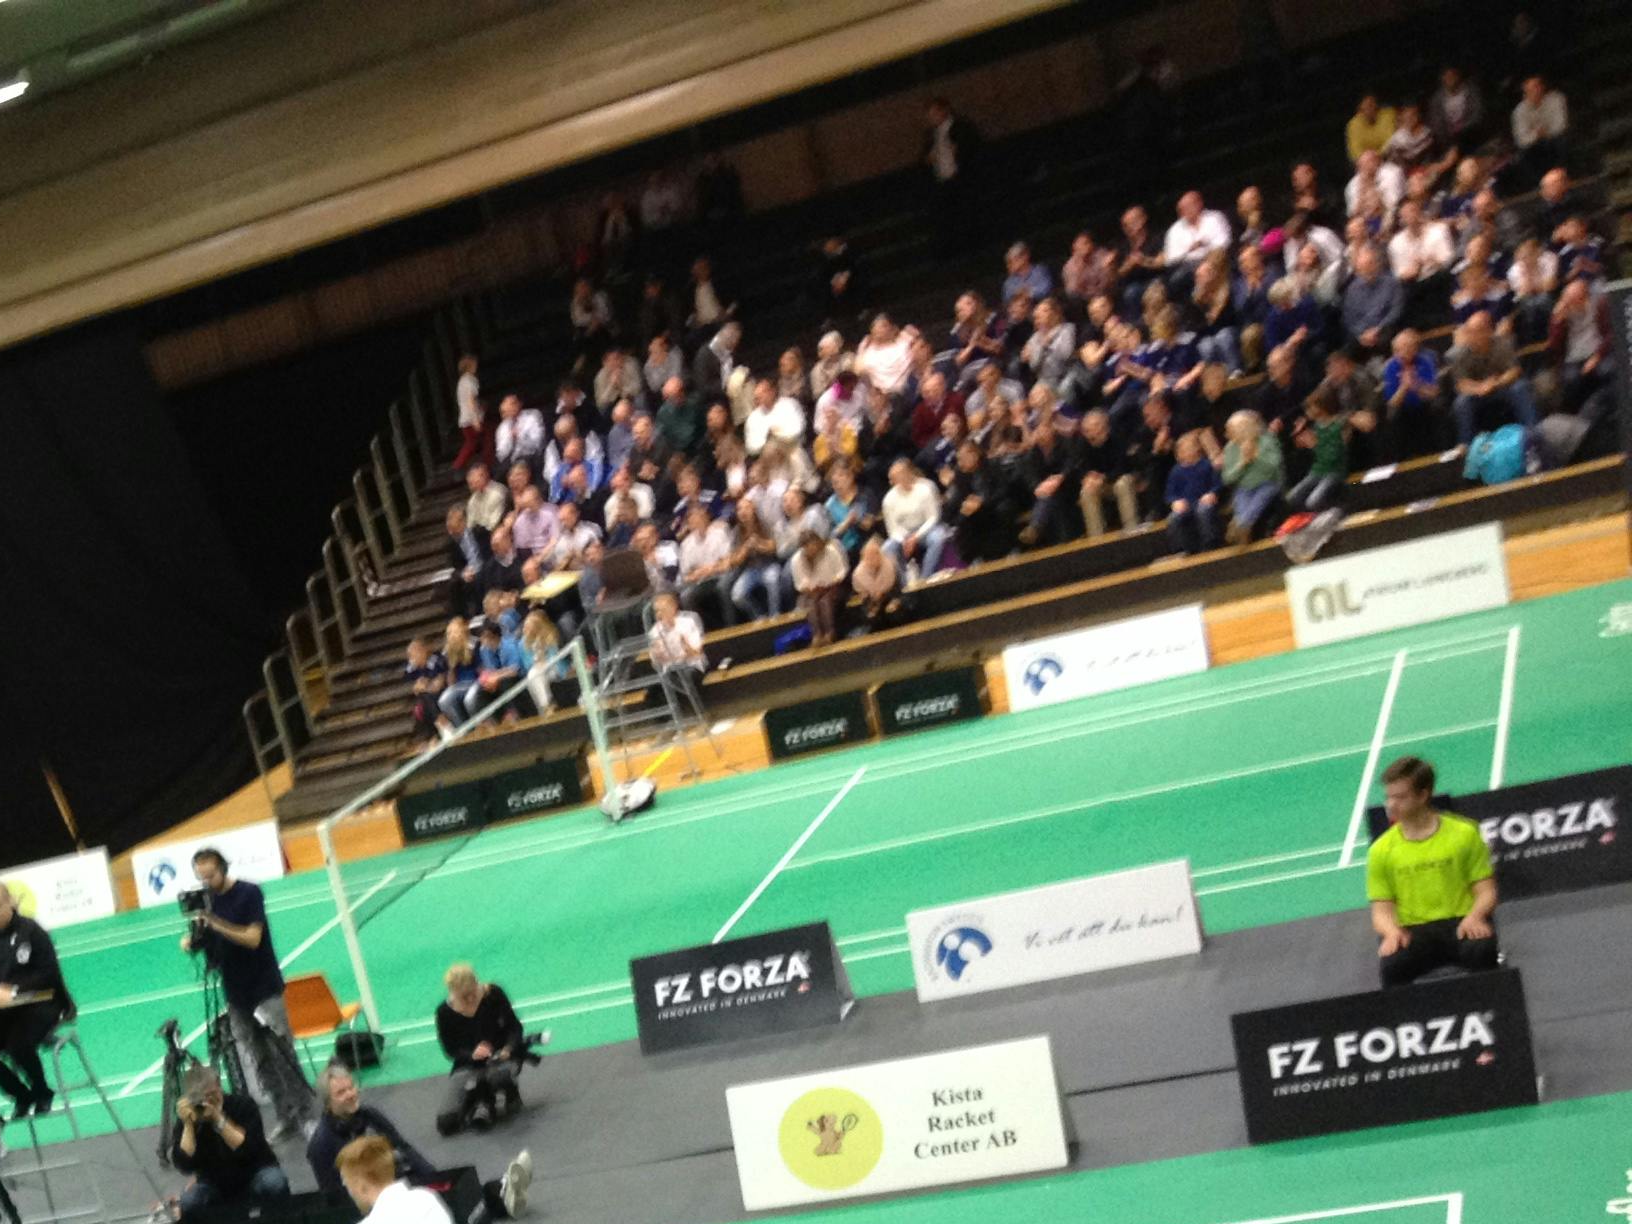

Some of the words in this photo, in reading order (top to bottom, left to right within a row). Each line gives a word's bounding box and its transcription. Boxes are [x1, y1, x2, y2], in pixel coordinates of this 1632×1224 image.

[1479, 797, 1616, 845] FORZA
[654, 972, 695, 1007] FZ
[699, 950, 811, 999] FORZA
[658, 1001, 717, 1021] INNOVATED
[736, 989, 787, 1008] DENMARK
[1268, 1037, 1324, 1079] FZ
[1334, 1012, 1494, 1068] FORZA
[1272, 1073, 1359, 1098] INNOVATED
[1364, 1072, 1382, 1084] IN
[1387, 1058, 1462, 1081] DENMARK
[931, 1087, 984, 1107] Kista
[927, 1107, 996, 1133] Racket
[913, 1137, 980, 1160] Center
[986, 1129, 1018, 1150] AB
